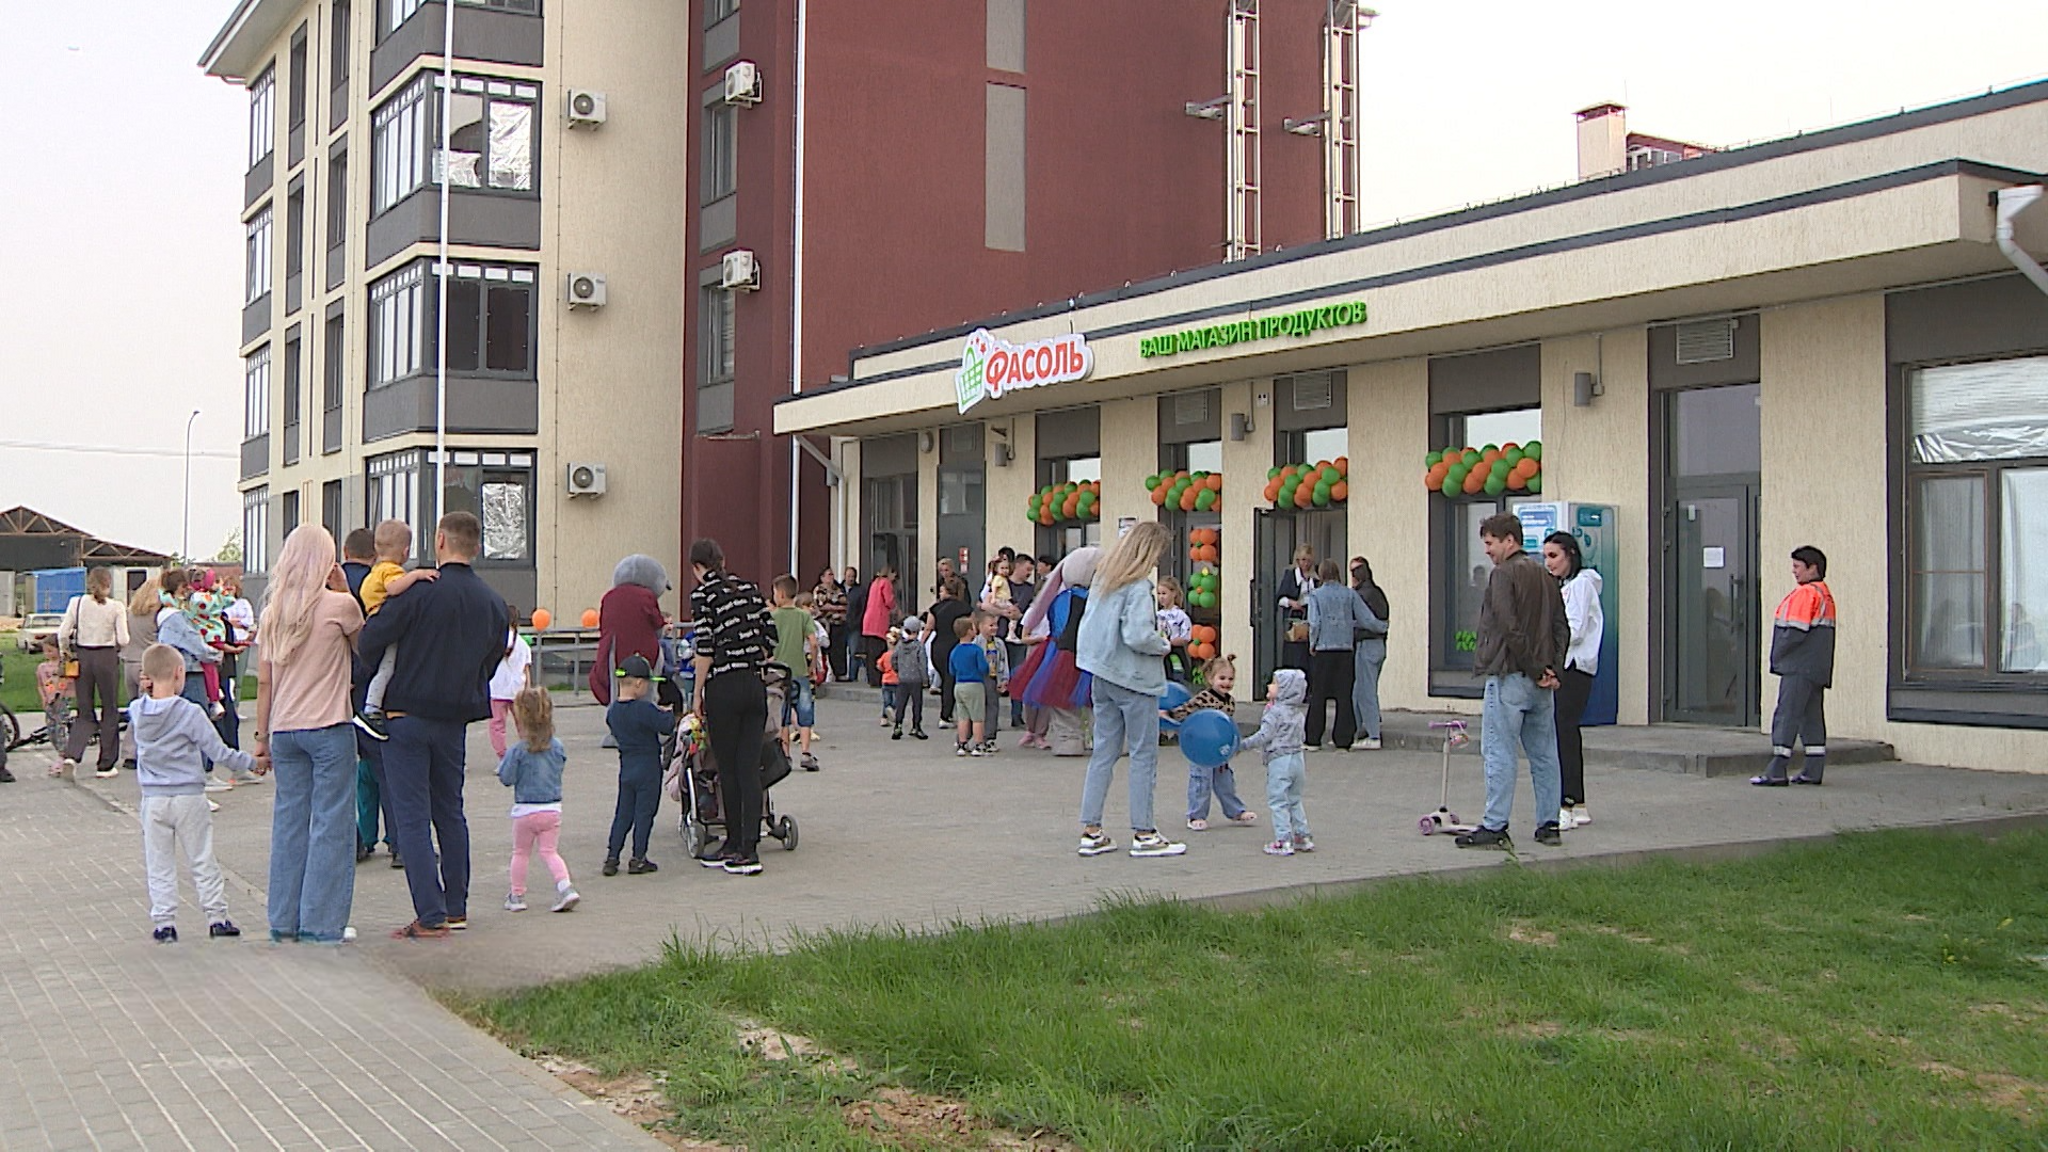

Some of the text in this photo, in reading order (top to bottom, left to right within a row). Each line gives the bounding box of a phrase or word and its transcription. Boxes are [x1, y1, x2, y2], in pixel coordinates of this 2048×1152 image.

[1140, 301, 1367, 358] ВАШ МАГАЗИН ПРОДУКТОВ
[986, 340, 1083, 386] ФАСОЛЬ
